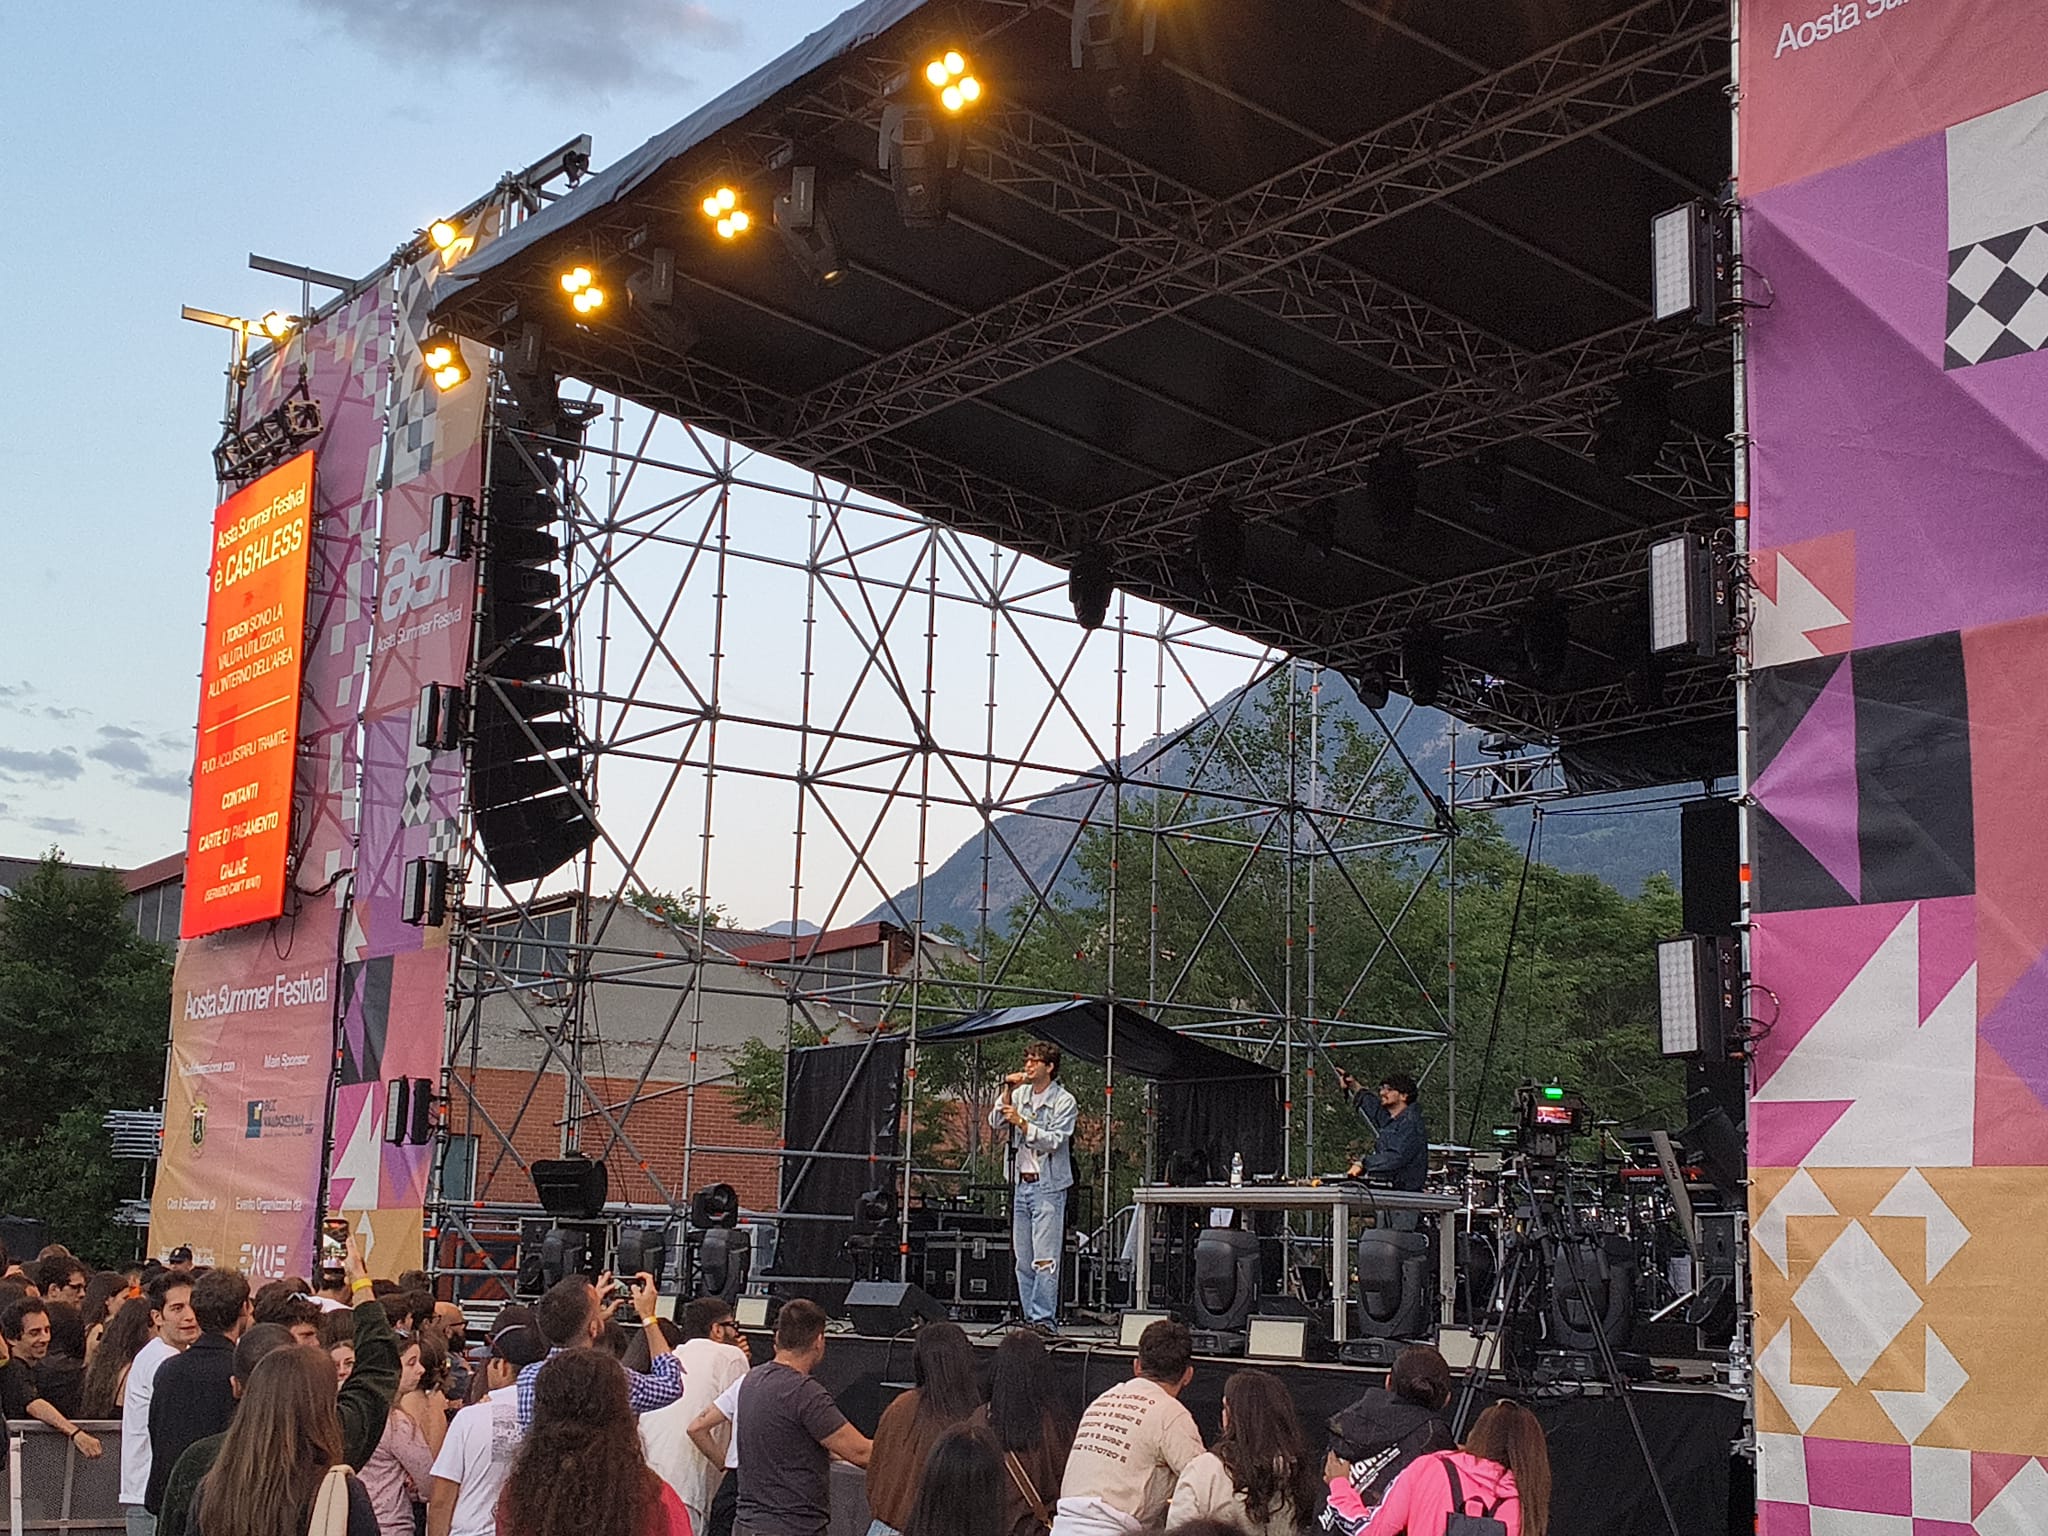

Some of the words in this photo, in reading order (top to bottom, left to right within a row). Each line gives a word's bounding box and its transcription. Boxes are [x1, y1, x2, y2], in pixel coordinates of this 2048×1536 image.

[1773, 1, 1861, 59] Aosta
[217, 525, 239, 551] Aosta
[237, 508, 273, 538] Summer
[272, 482, 306, 519] Festival
[214, 560, 223, 593] è
[225, 518, 303, 586] CASHLESS
[249, 610, 272, 634] SONO
[271, 602, 284, 623] LA
[376, 633, 397, 652] Aosta
[396, 621, 433, 645] Summer
[431, 602, 464, 632] Festival
[218, 645, 244, 671] VALUTA
[244, 626, 285, 659] UTILIZZATA
[252, 646, 294, 678] DELL'AREA
[221, 782, 259, 810] CONTANTI
[198, 829, 223, 853] CARTE
[222, 826, 231, 845] DI
[231, 811, 279, 841] PAGAMENTO
[219, 856, 249, 881] ONLINE
[184, 990, 217, 1021] Aosta
[217, 984, 275, 1016] Summer
[274, 967, 328, 1007] Festival
[264, 1055, 281, 1068] Main
[280, 1053, 310, 1070] Sponsor
